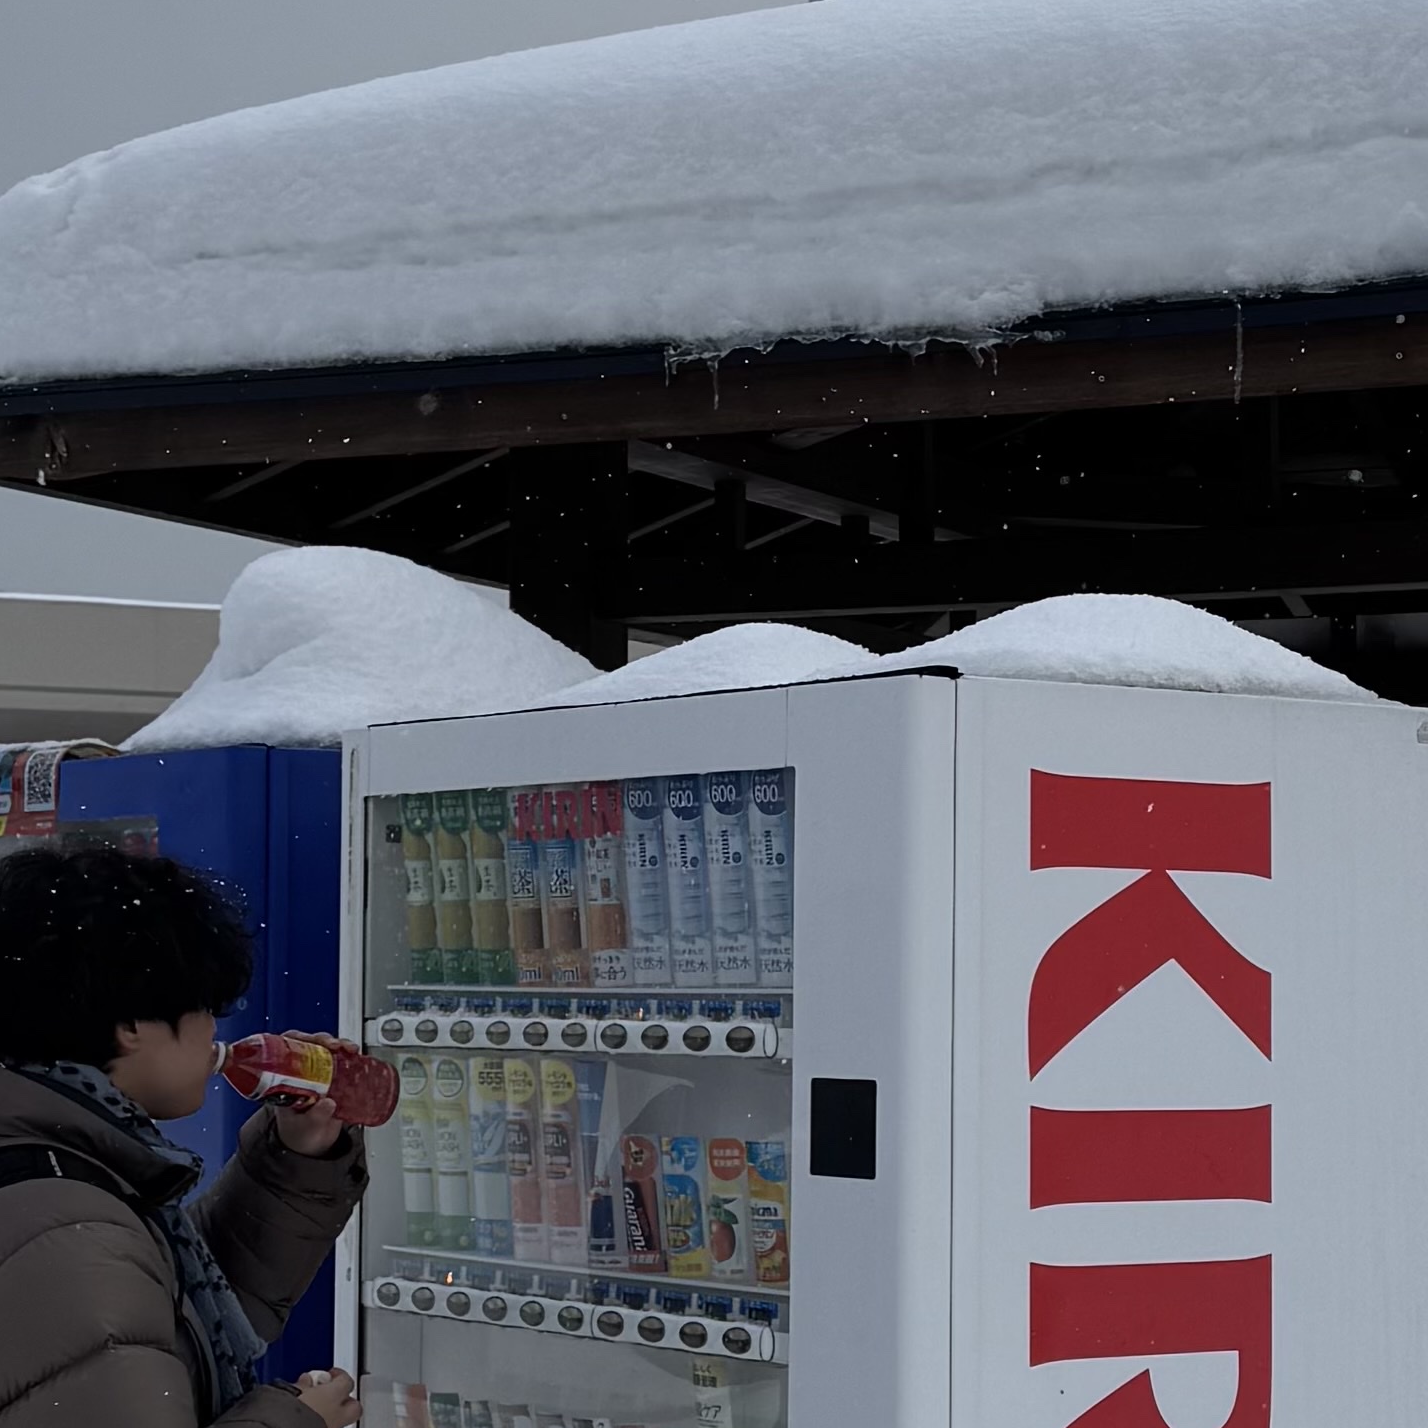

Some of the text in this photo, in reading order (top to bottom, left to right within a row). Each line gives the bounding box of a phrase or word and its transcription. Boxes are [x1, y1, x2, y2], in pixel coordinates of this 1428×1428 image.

[628, 790, 653, 808] 600
[669, 790, 693, 808] 600
[711, 784, 737, 804] 600
[754, 784, 778, 804] 600
[515, 786, 622, 843] KIRIN
